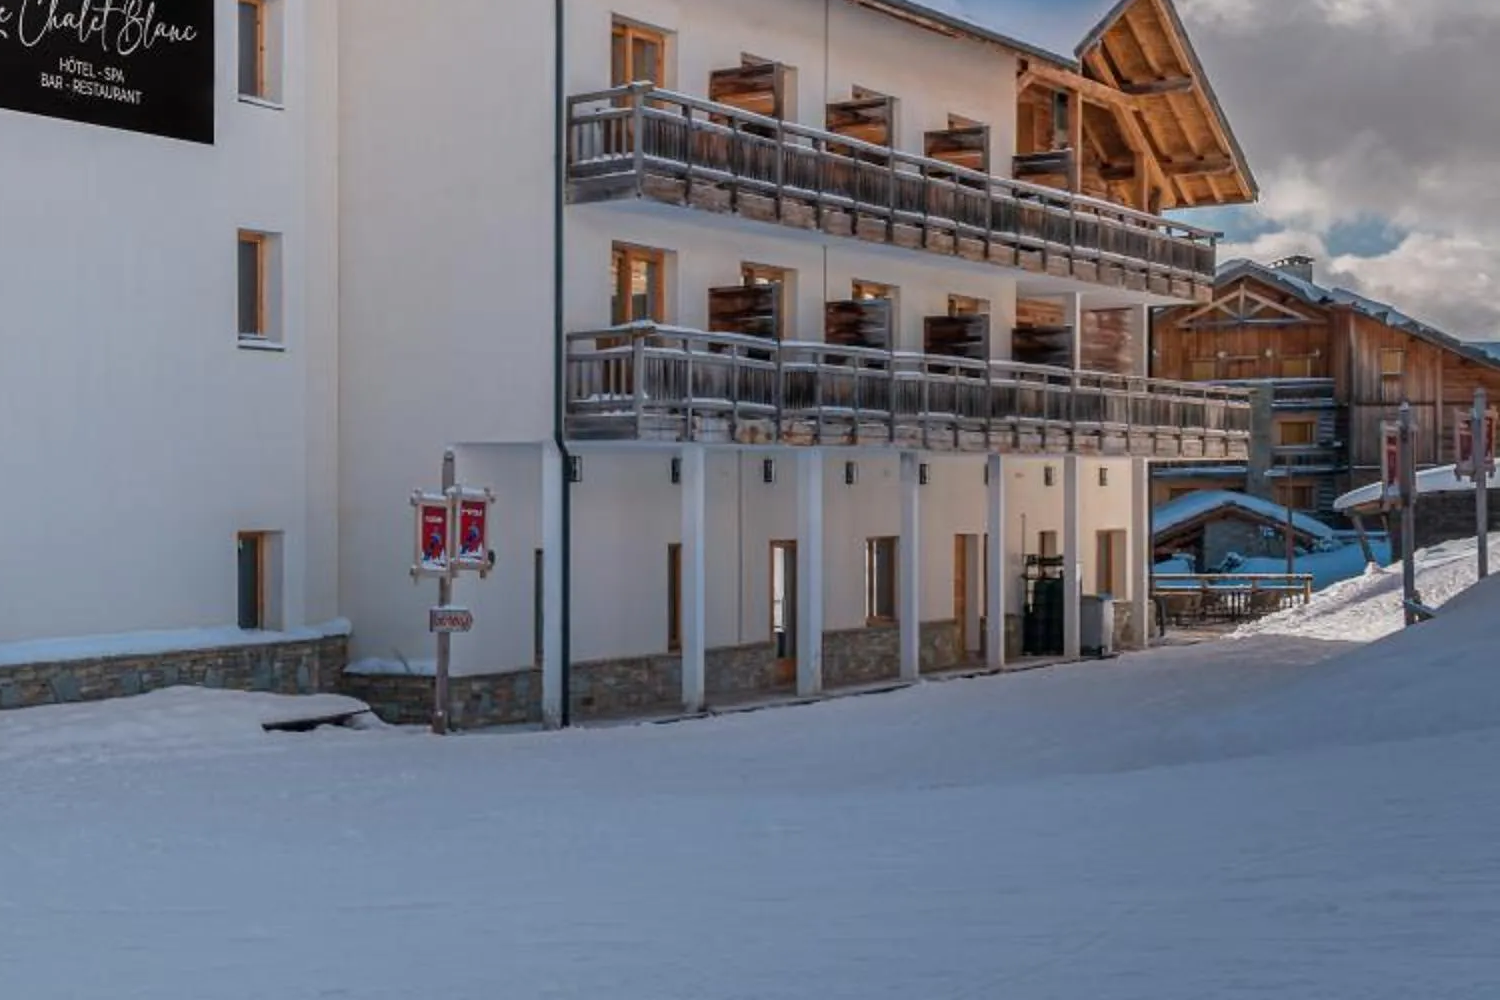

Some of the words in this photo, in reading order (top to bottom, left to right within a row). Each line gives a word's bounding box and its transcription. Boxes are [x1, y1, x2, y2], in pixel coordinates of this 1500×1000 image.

[59, 56, 96, 78] HÔTEL
[104, 67, 125, 83] SPA
[41, 72, 63, 89] BAR
[73, 79, 143, 104] RESTAURANT
